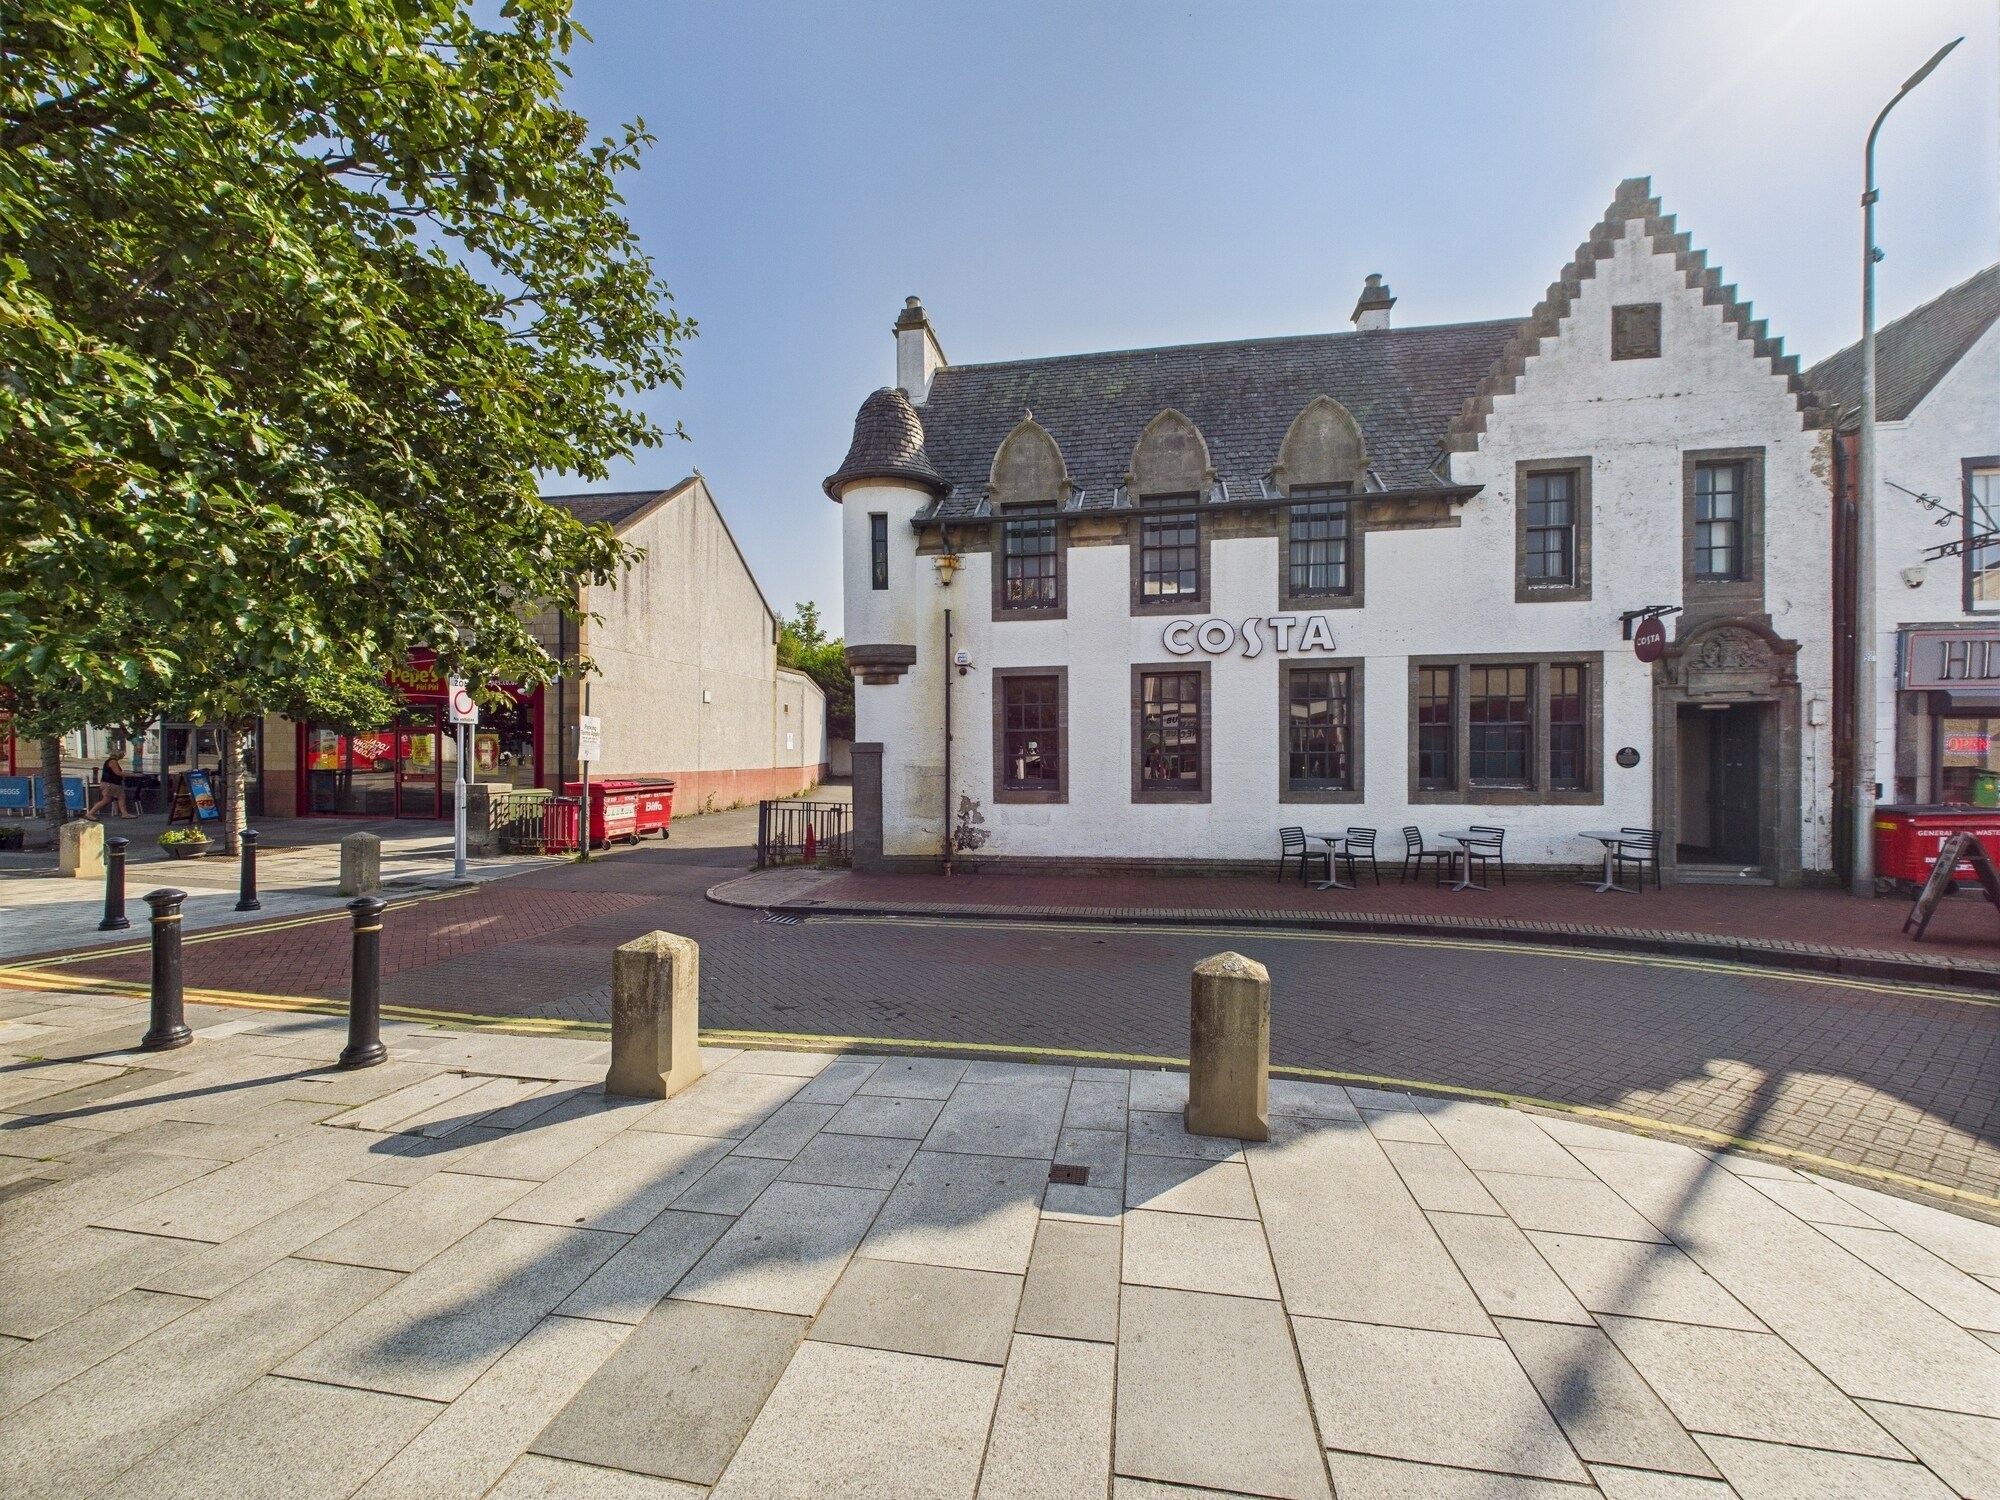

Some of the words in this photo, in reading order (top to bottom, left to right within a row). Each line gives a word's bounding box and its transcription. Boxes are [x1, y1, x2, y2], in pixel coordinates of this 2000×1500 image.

[1162, 616, 1337, 658] COSTA
[1637, 633, 1660, 646] COSTA
[391, 665, 439, 687] Pepe's
[1949, 737, 1988, 751] OPEN
[646, 801, 663, 812] Biffa
